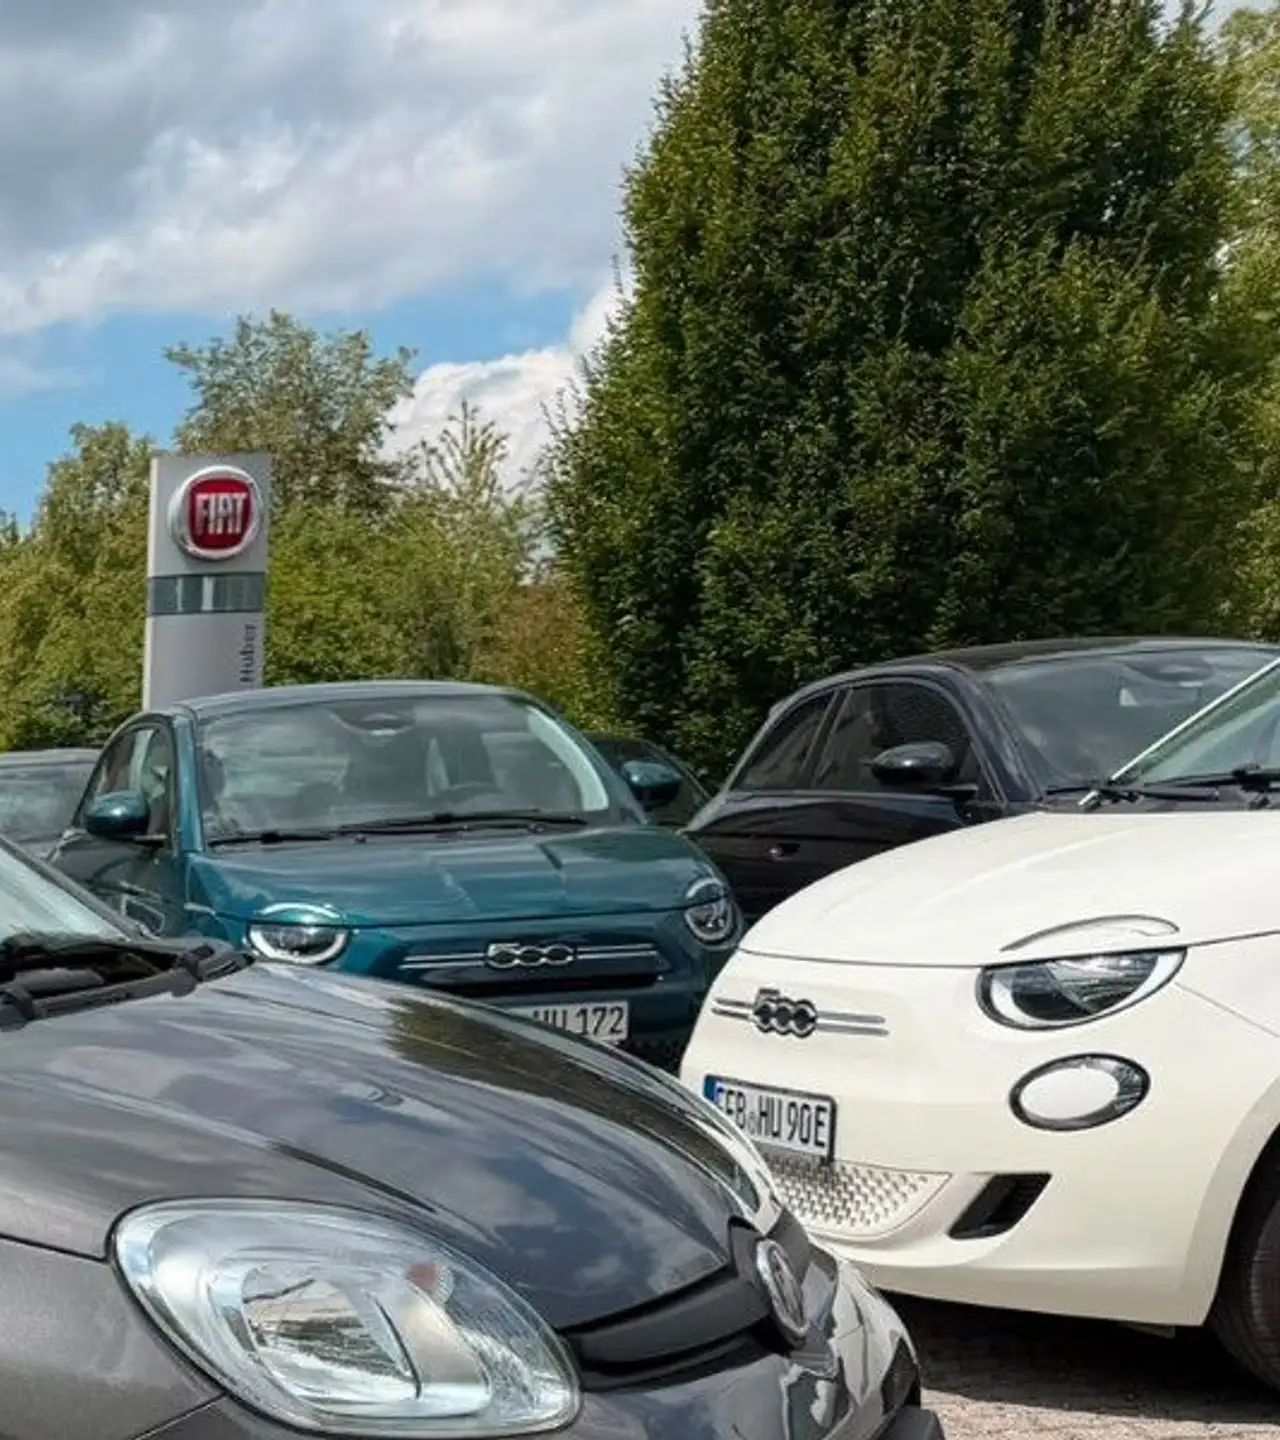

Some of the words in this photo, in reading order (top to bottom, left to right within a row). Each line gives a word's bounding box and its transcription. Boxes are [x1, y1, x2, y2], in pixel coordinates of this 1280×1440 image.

[195, 492, 247, 535] FIAT
[488, 943, 574, 968] 500
[576, 1006, 624, 1035] 172
[753, 988, 818, 1038] 500
[758, 1095, 782, 1138] HU
